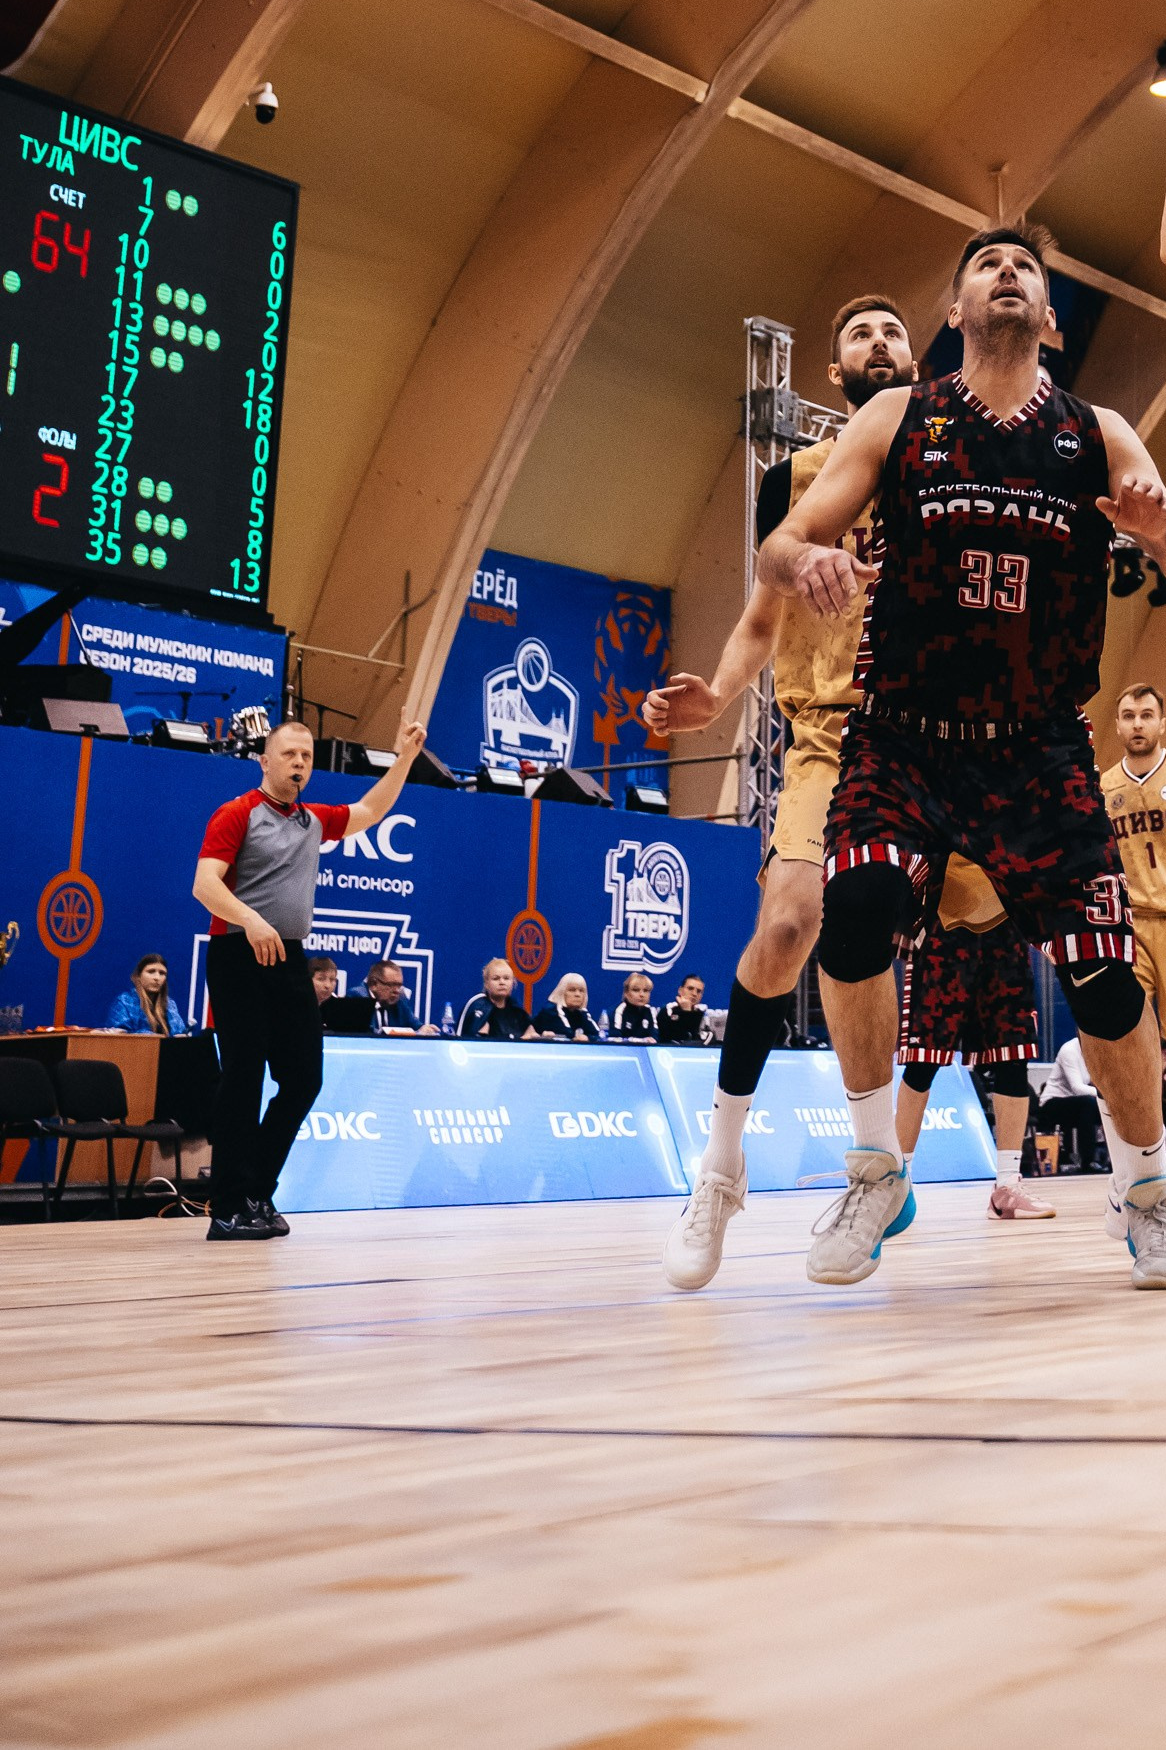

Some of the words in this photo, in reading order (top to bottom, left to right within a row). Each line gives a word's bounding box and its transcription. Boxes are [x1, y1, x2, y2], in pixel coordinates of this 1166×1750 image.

[19, 133, 75, 176] ТУЛА
[58, 110, 142, 172] ЦИВС
[49, 183, 87, 209] СЧЕТ
[142, 175, 153, 207] 1
[272, 220, 287, 251] 6
[31, 209, 92, 279] 64
[137, 205, 155, 237] 7
[269, 250, 285, 281] 0
[118, 232, 150, 270] 10
[267, 280, 283, 311] 0
[114, 264, 144, 302] 11
[263, 310, 280, 343] 2
[111, 296, 144, 334] 13
[261, 341, 278, 372] 0
[108, 329, 140, 366] 15
[245, 368, 275, 404] 12
[104, 361, 139, 398] 17
[242, 399, 273, 434] 18
[37, 426, 77, 451] ФОЛЫ
[97, 393, 135, 432] 23
[254, 434, 270, 466] 0
[1057, 439, 1078, 449] РФБ
[94, 427, 133, 464] 27
[251, 465, 267, 497] 0
[923, 451, 949, 462] STK
[32, 452, 69, 528] 2
[91, 460, 129, 498] 28
[248, 496, 265, 529] 5
[918, 484, 1044, 502] БАСКЕТБОЛЬНЫЙ
[88, 493, 122, 532] 31
[246, 529, 263, 561] 8
[920, 498, 1071, 542] РЯЗАНЬ
[85, 527, 122, 565] 35
[229, 557, 261, 593] 13
[958, 549, 1030, 614] 33
[470, 568, 518, 610] ЕРЁД
[81, 623, 134, 650] СРЕДИ
[135, 634, 212, 664] МУЖСКИХ
[213, 648, 274, 678] КОМАНД
[132, 657, 197, 684] 2025/26
[319, 814, 416, 863] KC
[1144, 842, 1158, 870] 1
[337, 874, 414, 898] спонсор
[348, 936, 382, 955] ЦФО
[625, 912, 681, 940] ТВЕРЬ
[310, 1111, 381, 1140] DKC
[413, 1106, 511, 1127] ТИТУЛЬНЫЙ
[429, 1126, 503, 1145] СПОНСОР
[576, 1111, 637, 1138] DKC
